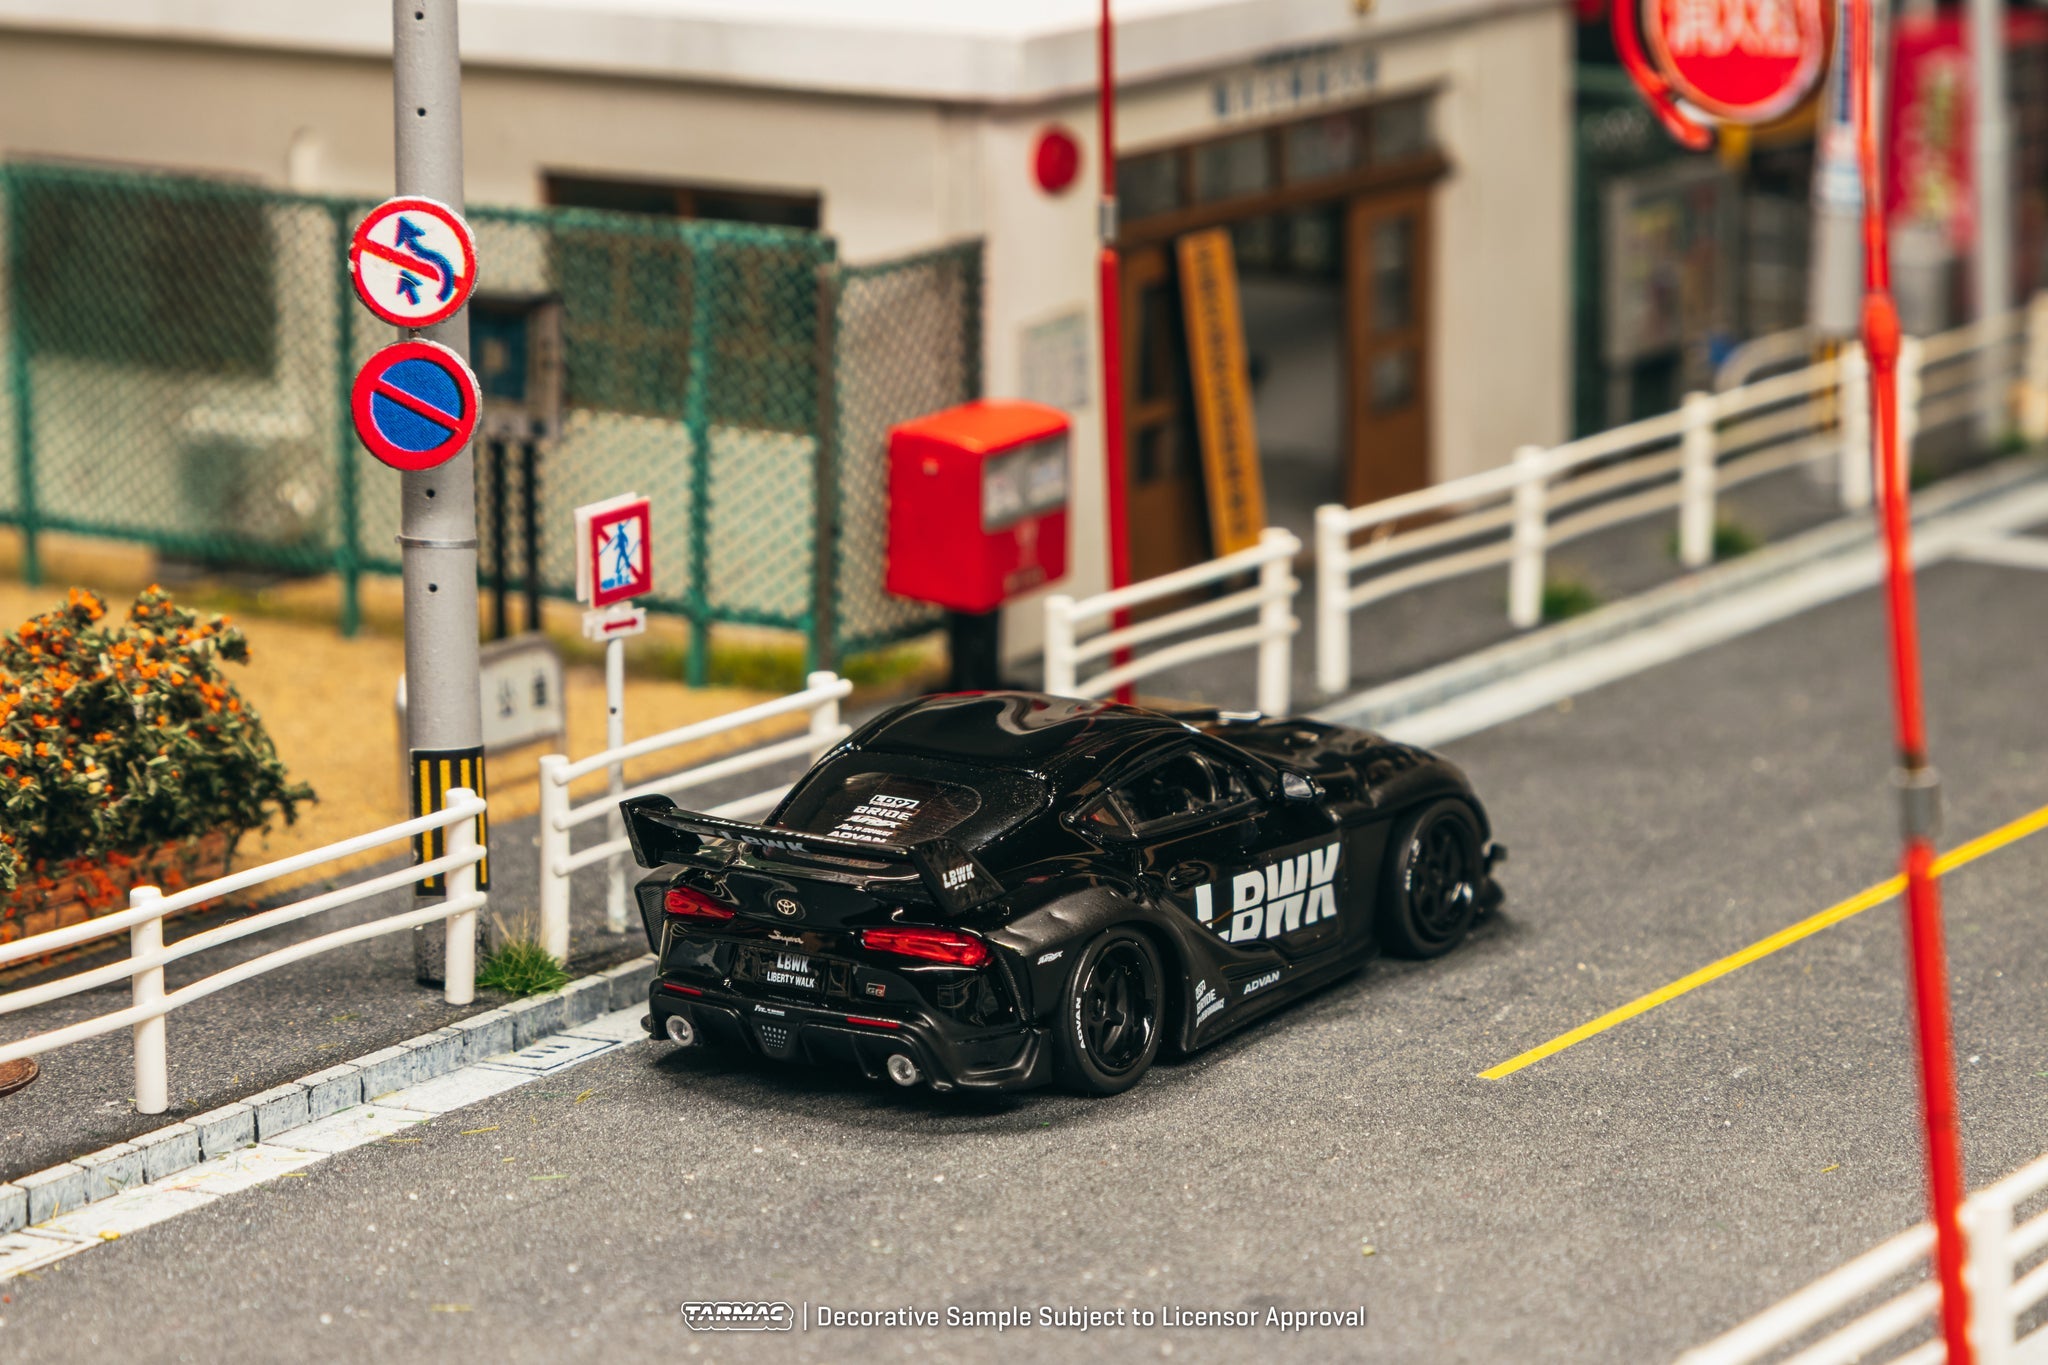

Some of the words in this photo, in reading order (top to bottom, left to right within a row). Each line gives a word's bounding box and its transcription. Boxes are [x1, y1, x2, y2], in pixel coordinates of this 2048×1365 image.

[853, 805, 913, 821] BRIDE
[826, 830, 887, 843] ADVAN
[942, 862, 975, 889] LBWK
[1195, 842, 1340, 942] LBWK
[768, 930, 804, 946] Supra
[777, 952, 810, 973] LBWK
[766, 970, 794, 985] LIBERTY
[795, 975, 815, 989] WALK
[1243, 971, 1280, 995] ADVAN
[1075, 997, 1086, 1049] ADVAN
